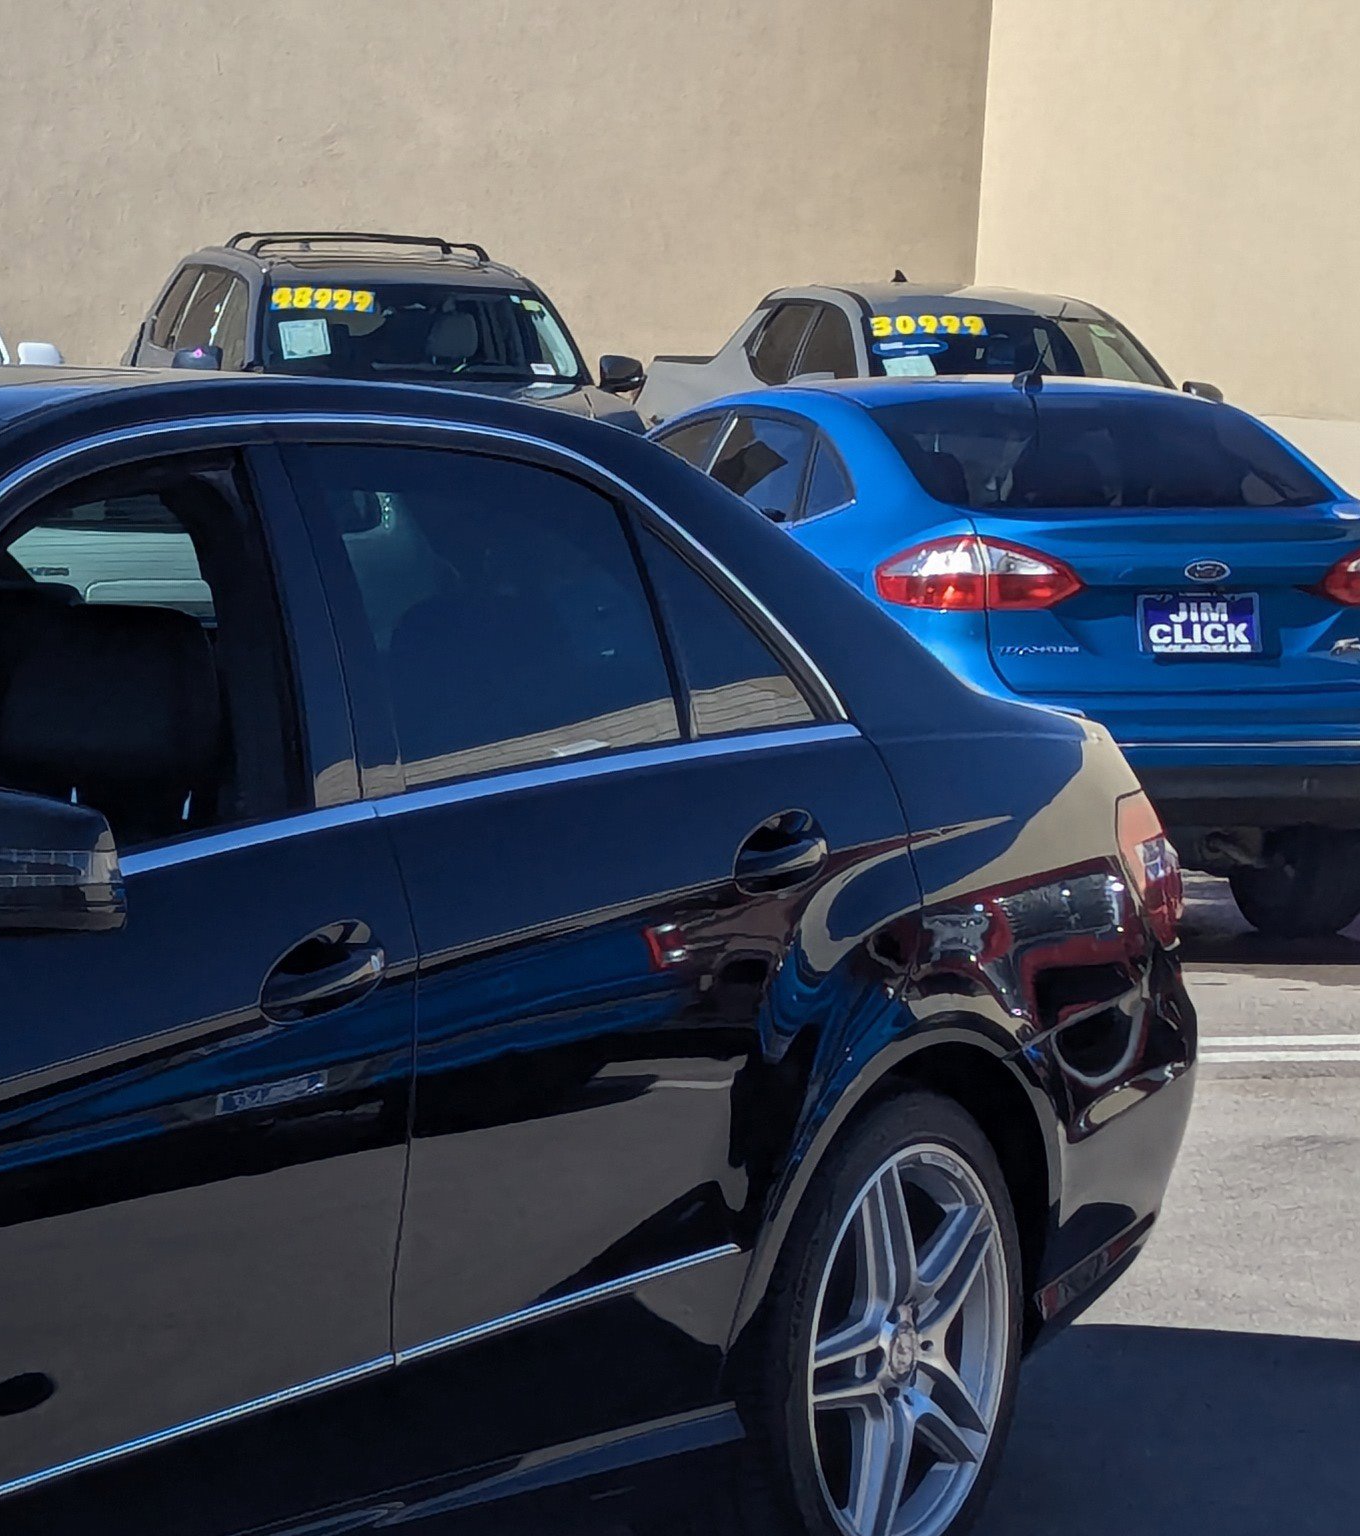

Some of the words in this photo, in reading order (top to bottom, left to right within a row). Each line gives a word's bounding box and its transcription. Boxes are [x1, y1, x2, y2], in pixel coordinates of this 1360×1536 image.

[870, 315, 986, 336] 30999
[1168, 602, 1228, 623] JIM
[1148, 623, 1250, 644] CLICK
